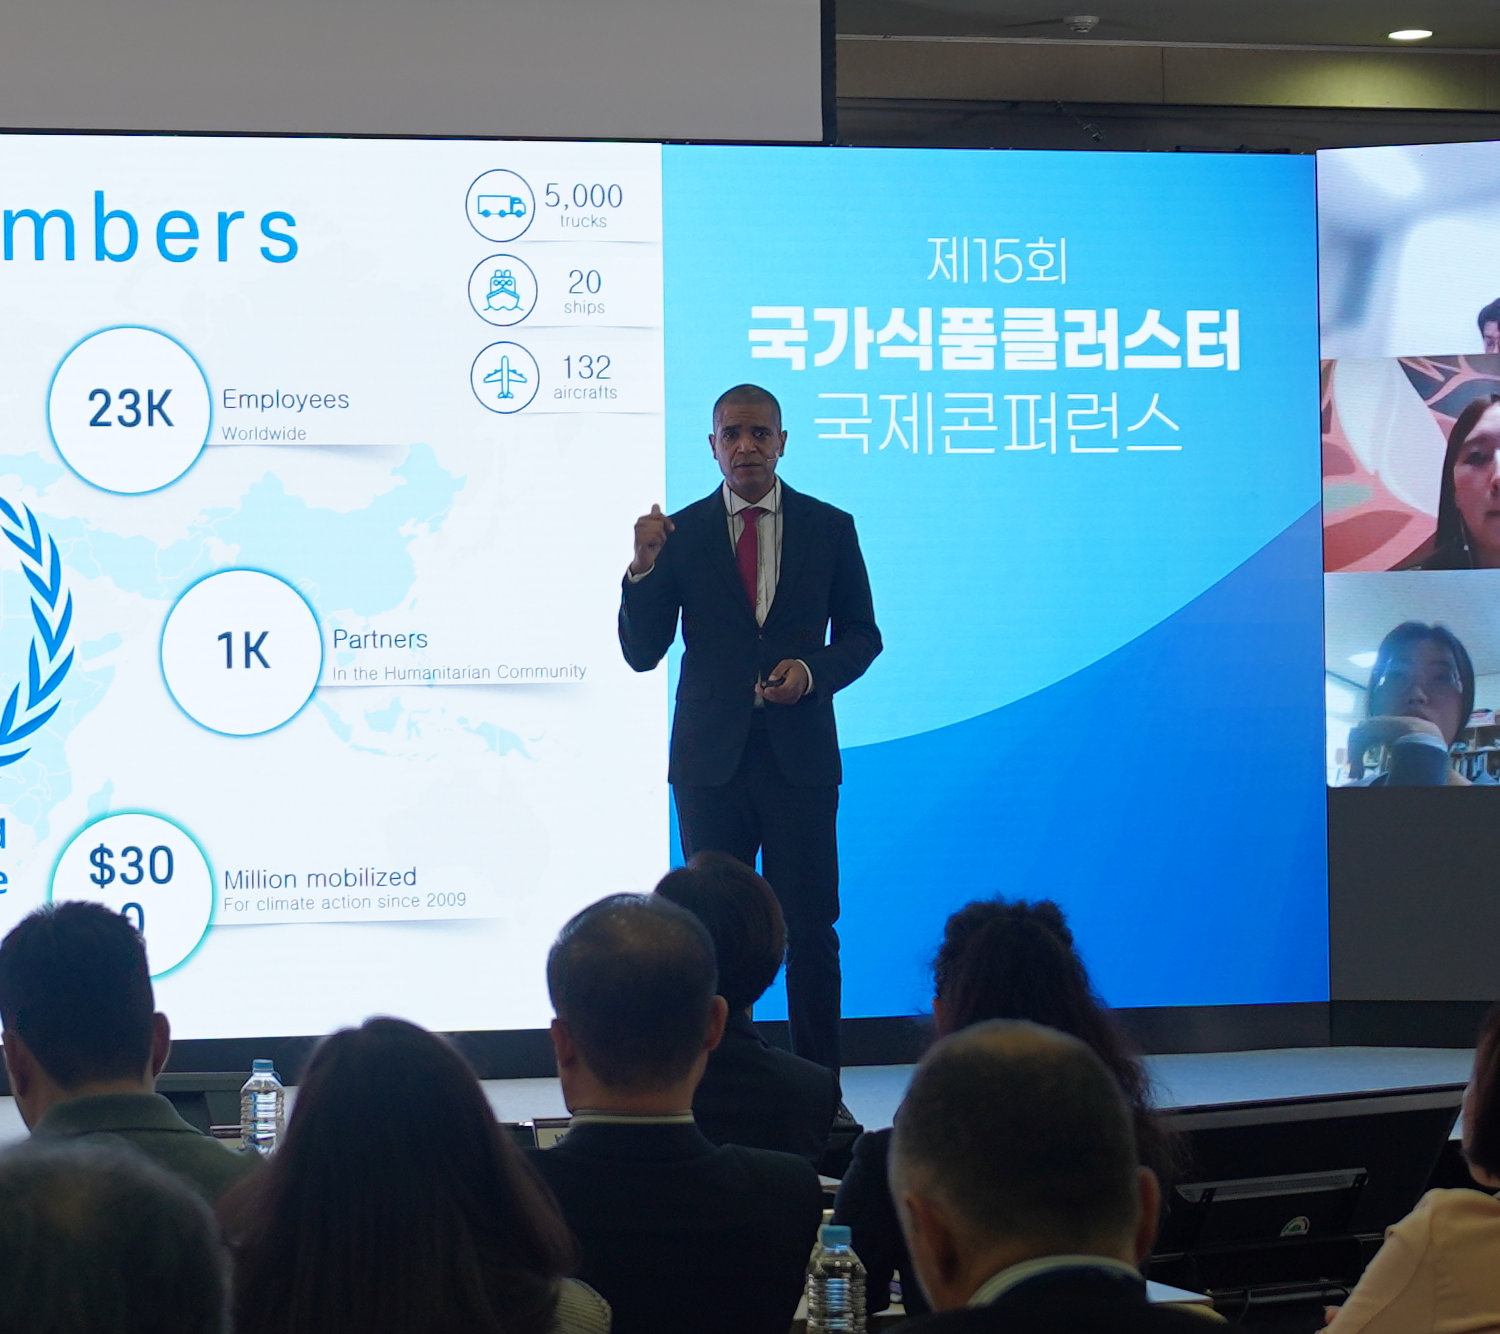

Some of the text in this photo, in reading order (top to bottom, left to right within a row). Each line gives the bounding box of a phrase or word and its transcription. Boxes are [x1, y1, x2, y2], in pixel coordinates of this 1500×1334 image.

[545, 183, 622, 210] 5,000
[561, 214, 607, 228] trucks
[926, 236, 1068, 284] 제15회
[569, 270, 601, 294] 20
[564, 300, 605, 315] ships
[748, 305, 1241, 371] 국가식품클러스터
[564, 355, 611, 379] 132
[224, 389, 349, 413] Employees
[554, 385, 617, 399] aircrafts
[88, 388, 174, 427] 23K
[222, 426, 306, 440] Worldwide
[813, 391, 1183, 455] 국제콘퍼런스
[217, 631, 271, 669] 1K
[334, 629, 428, 649] Partners
[334, 665, 586, 681] In the Humanitarian Community
[89, 843, 174, 889] $30
[225, 866, 416, 890] Million mobilized
[223, 892, 466, 911] For climate action since 2009
